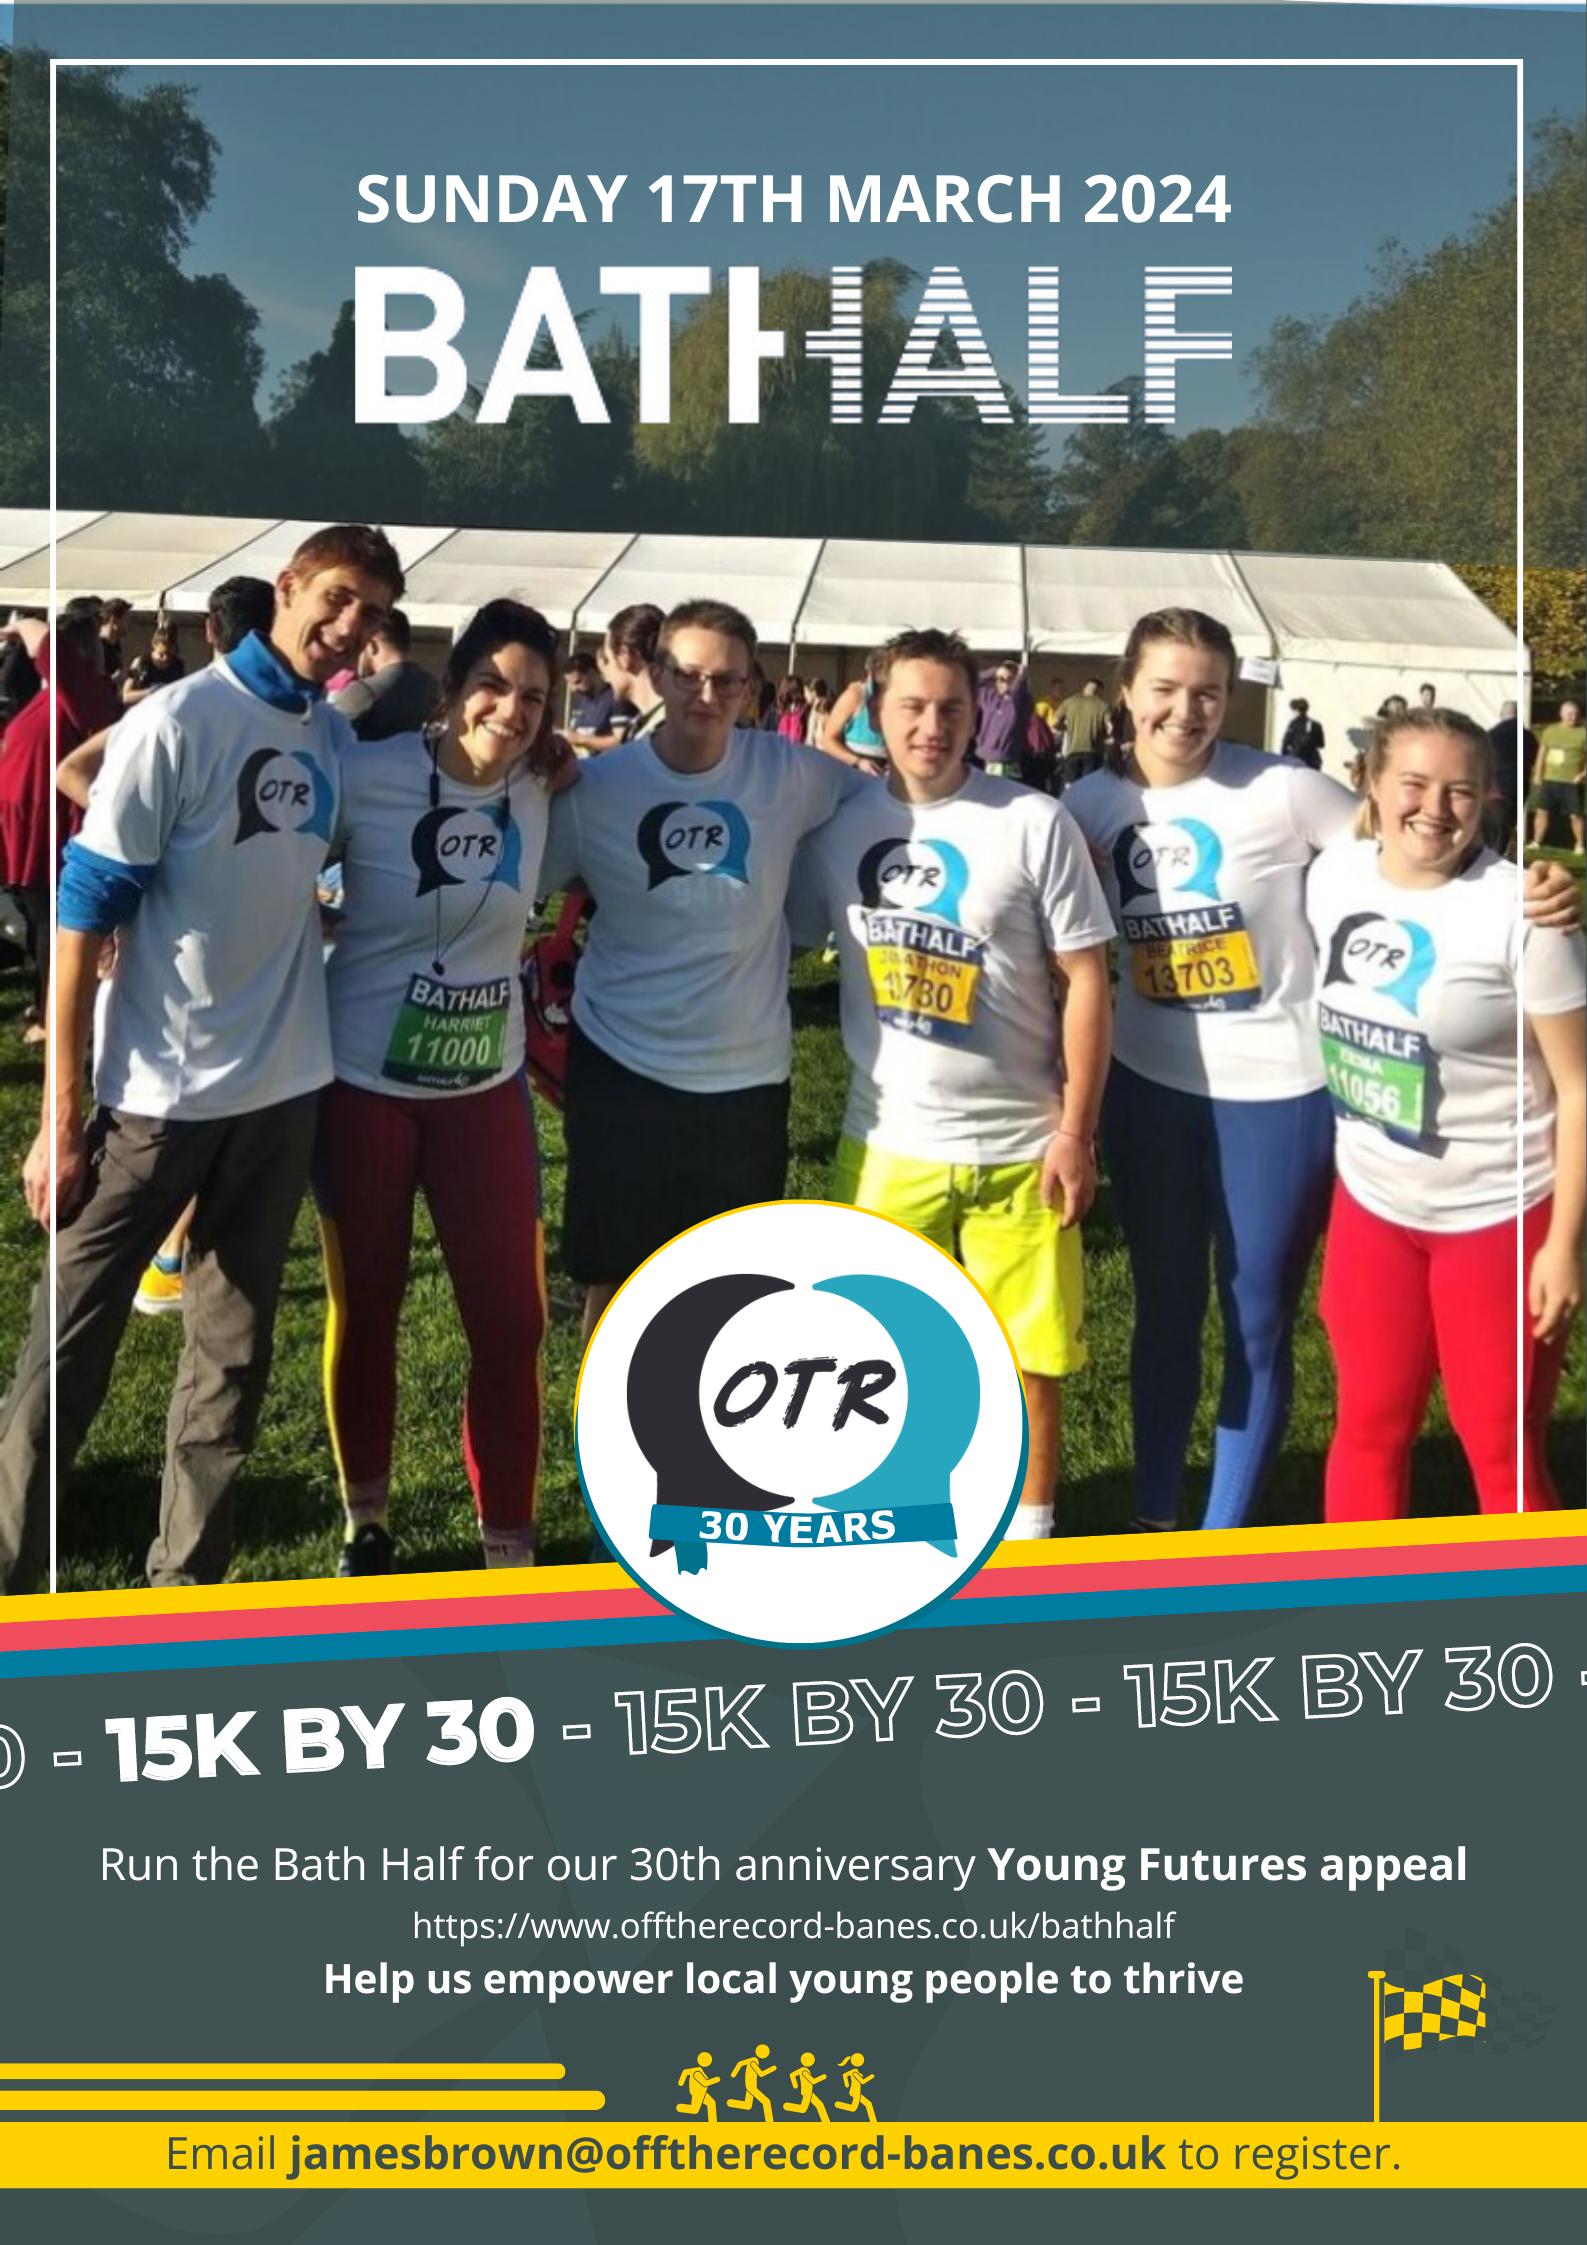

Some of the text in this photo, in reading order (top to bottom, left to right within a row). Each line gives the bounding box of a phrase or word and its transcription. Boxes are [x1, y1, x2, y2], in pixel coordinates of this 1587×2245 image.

[258, 778, 311, 807] OTR
[440, 834, 498, 859] OTR
[664, 824, 725, 851] OTR
[1133, 845, 1192, 871] OTR
[881, 863, 938, 889] OTR
[868, 918, 979, 959] BATHALF
[1125, 906, 1236, 939] BATHALF
[1347, 937, 1405, 971] OTR
[1144, 956, 1235, 993] 13703
[411, 979, 510, 1012] BATHALF
[424, 1013, 493, 1033] HARRIET
[1320, 1003, 1421, 1060] BATHALF
[407, 1033, 491, 1067] 11000
[1327, 1061, 1401, 1121] 11056
